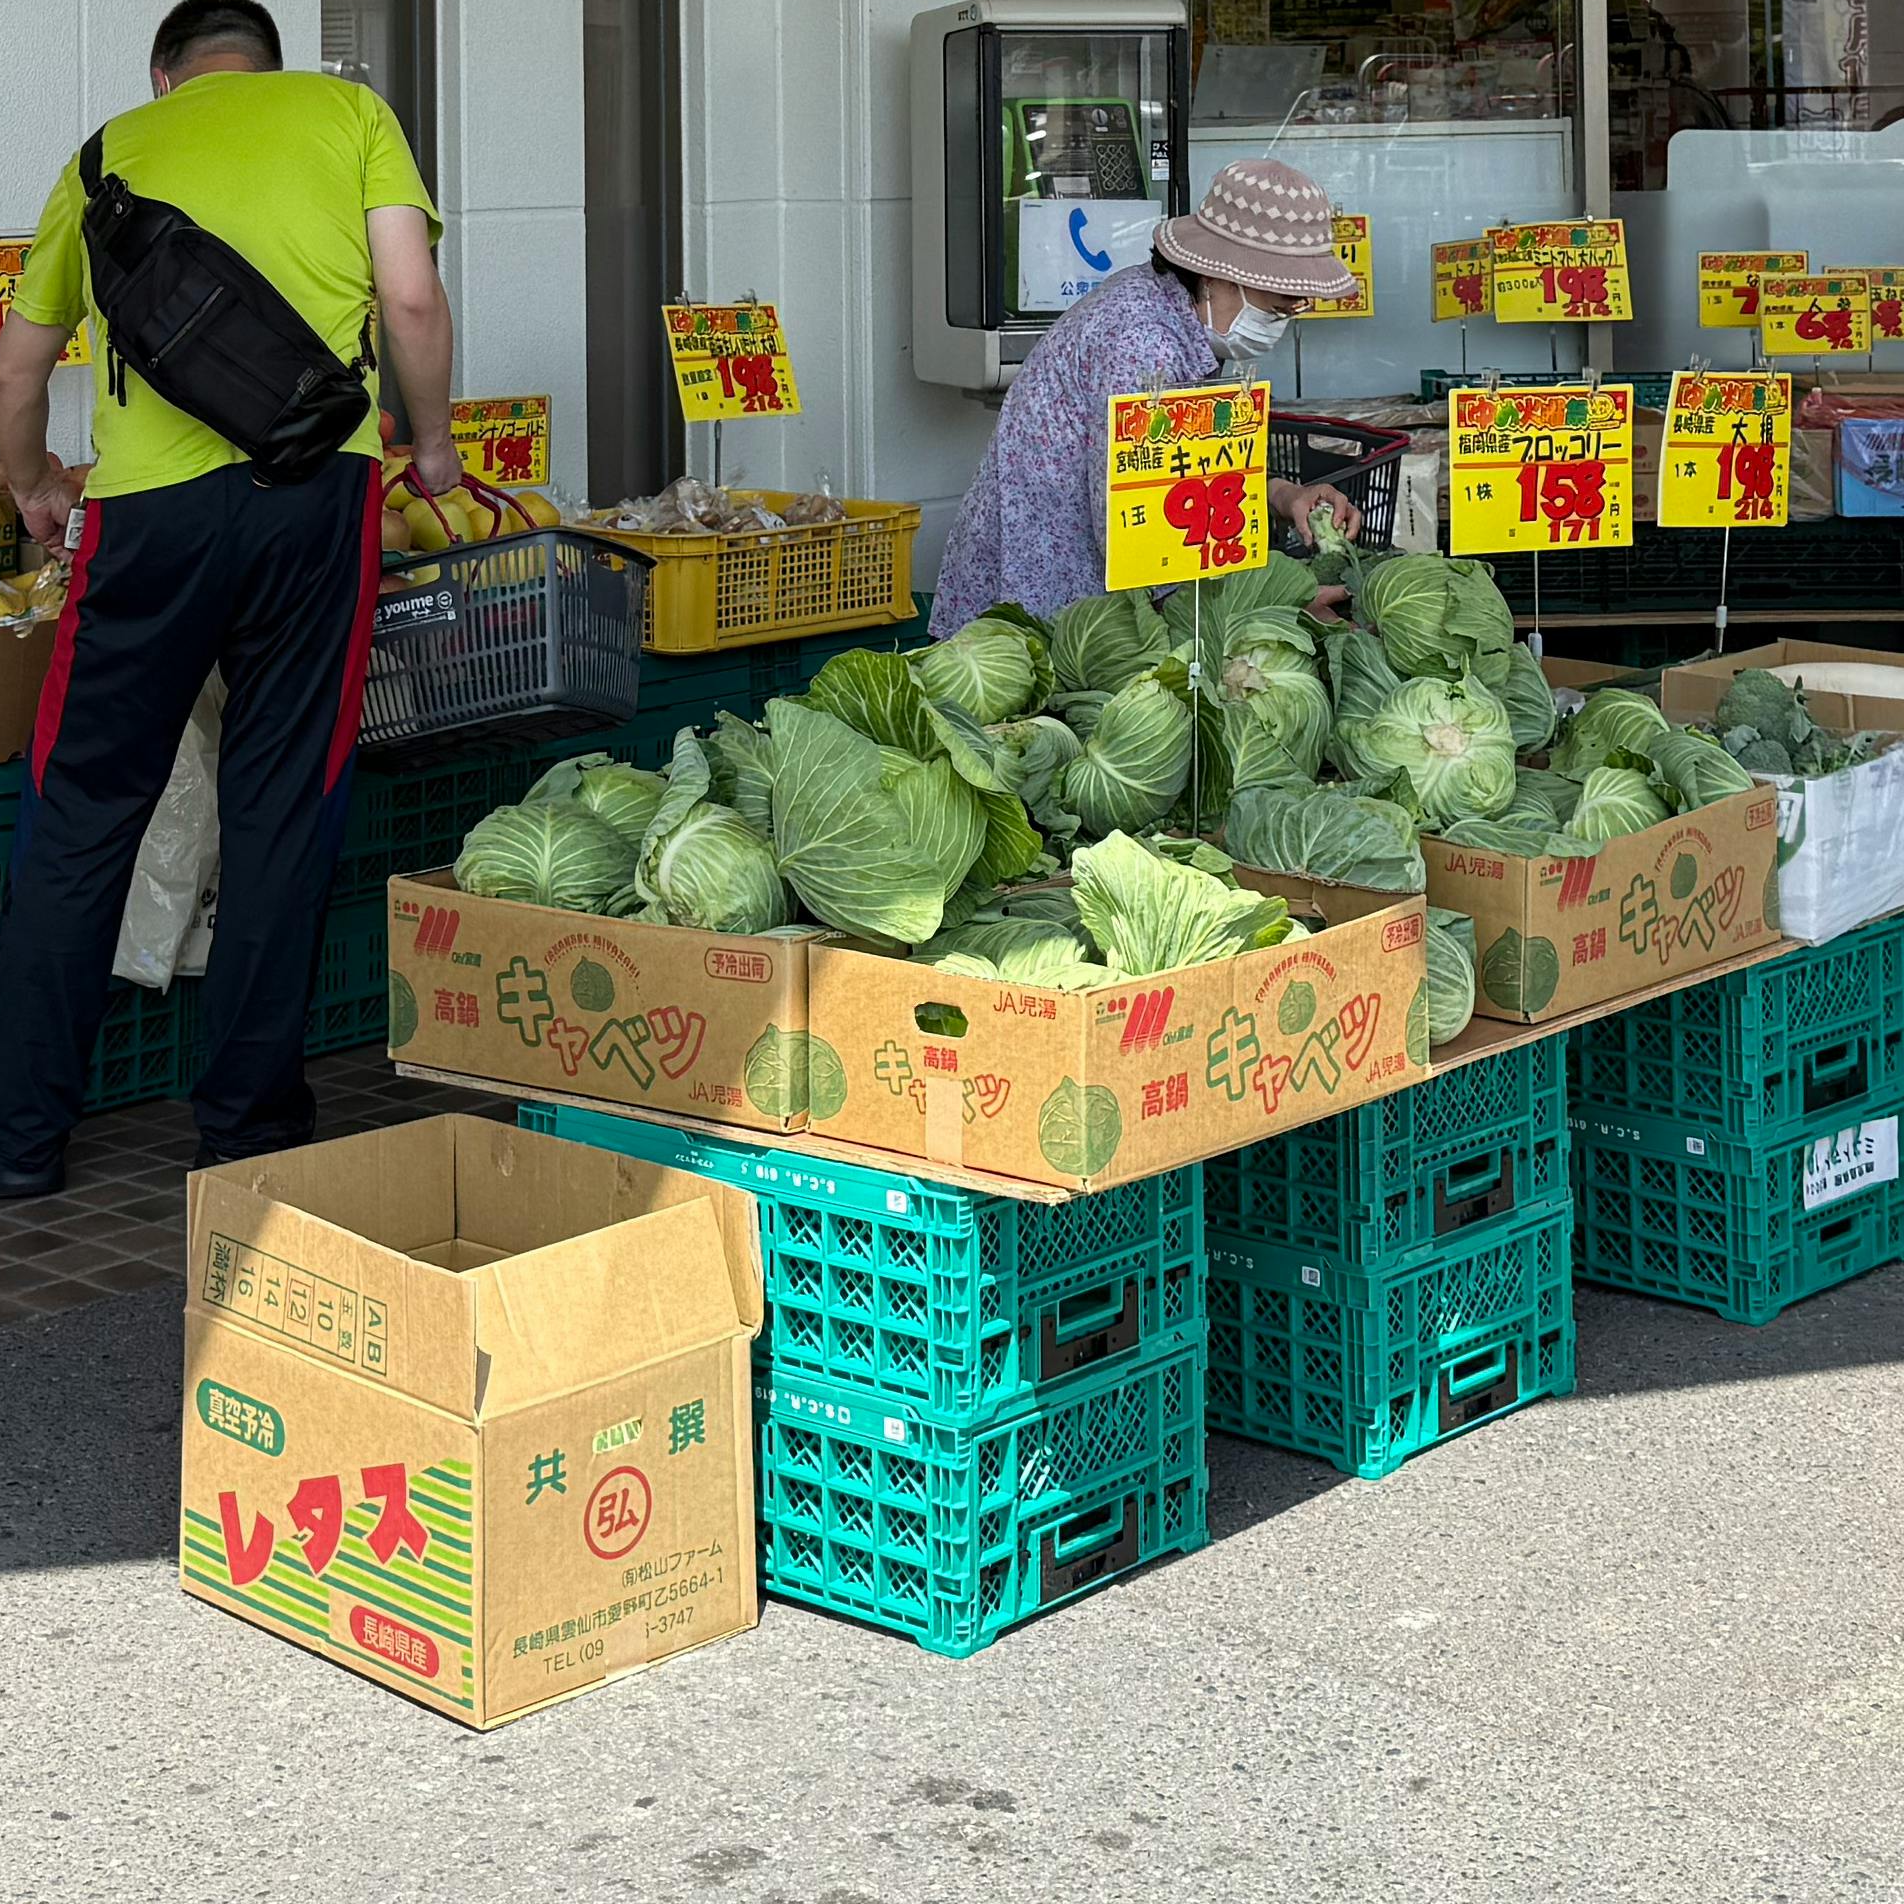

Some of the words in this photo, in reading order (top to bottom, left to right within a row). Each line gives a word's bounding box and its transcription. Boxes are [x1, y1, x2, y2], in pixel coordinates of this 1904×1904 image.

[1455, 260, 1486, 278] トマト
[1540, 266, 1609, 304] 198
[1563, 303, 1613, 317] 214
[1795, 310, 1853, 340] 68
[717, 355, 778, 398] 198
[740, 395, 784, 413] 214
[478, 421, 545, 440] シナノゴールド
[1731, 412, 1774, 447] 大根
[483, 437, 534, 472] 198
[1115, 446, 1165, 473] 宮崎県産
[1170, 438, 1254, 478] キャベツ
[1459, 432, 1512, 455] 福岡県産
[1512, 432, 1622, 463] ブロッコリー
[1717, 444, 1775, 500] 198
[1516, 460, 1606, 522] 158
[1163, 472, 1247, 546] 98
[1734, 497, 1774, 521] 214
[1547, 517, 1601, 543] 171
[1199, 537, 1247, 571] 106
[384, 594, 434, 618] youme
[1619, 863, 1745, 966] キャベツ
[1572, 927, 1607, 967] 高鍋
[433, 987, 480, 1028] 高鍋
[496, 954, 707, 1091] キャベツ
[993, 990, 1057, 1021] JA児湯
[922, 1045, 959, 1073] 高鍋
[1205, 992, 1382, 1115] キャベツ
[688, 1081, 743, 1107] JA児湯
[1141, 1072, 1189, 1121] 高鍋
[237, 1266, 256, 1299] 16
[265, 1277, 282, 1309] 14
[289, 1286, 309, 1322] 12
[316, 1299, 336, 1333] 10
[208, 1386, 276, 1451] 真空予冷
[525, 1447, 568, 1506] 共
[217, 1462, 431, 1587] レタス
[361, 1614, 429, 1673] 長崎県産
